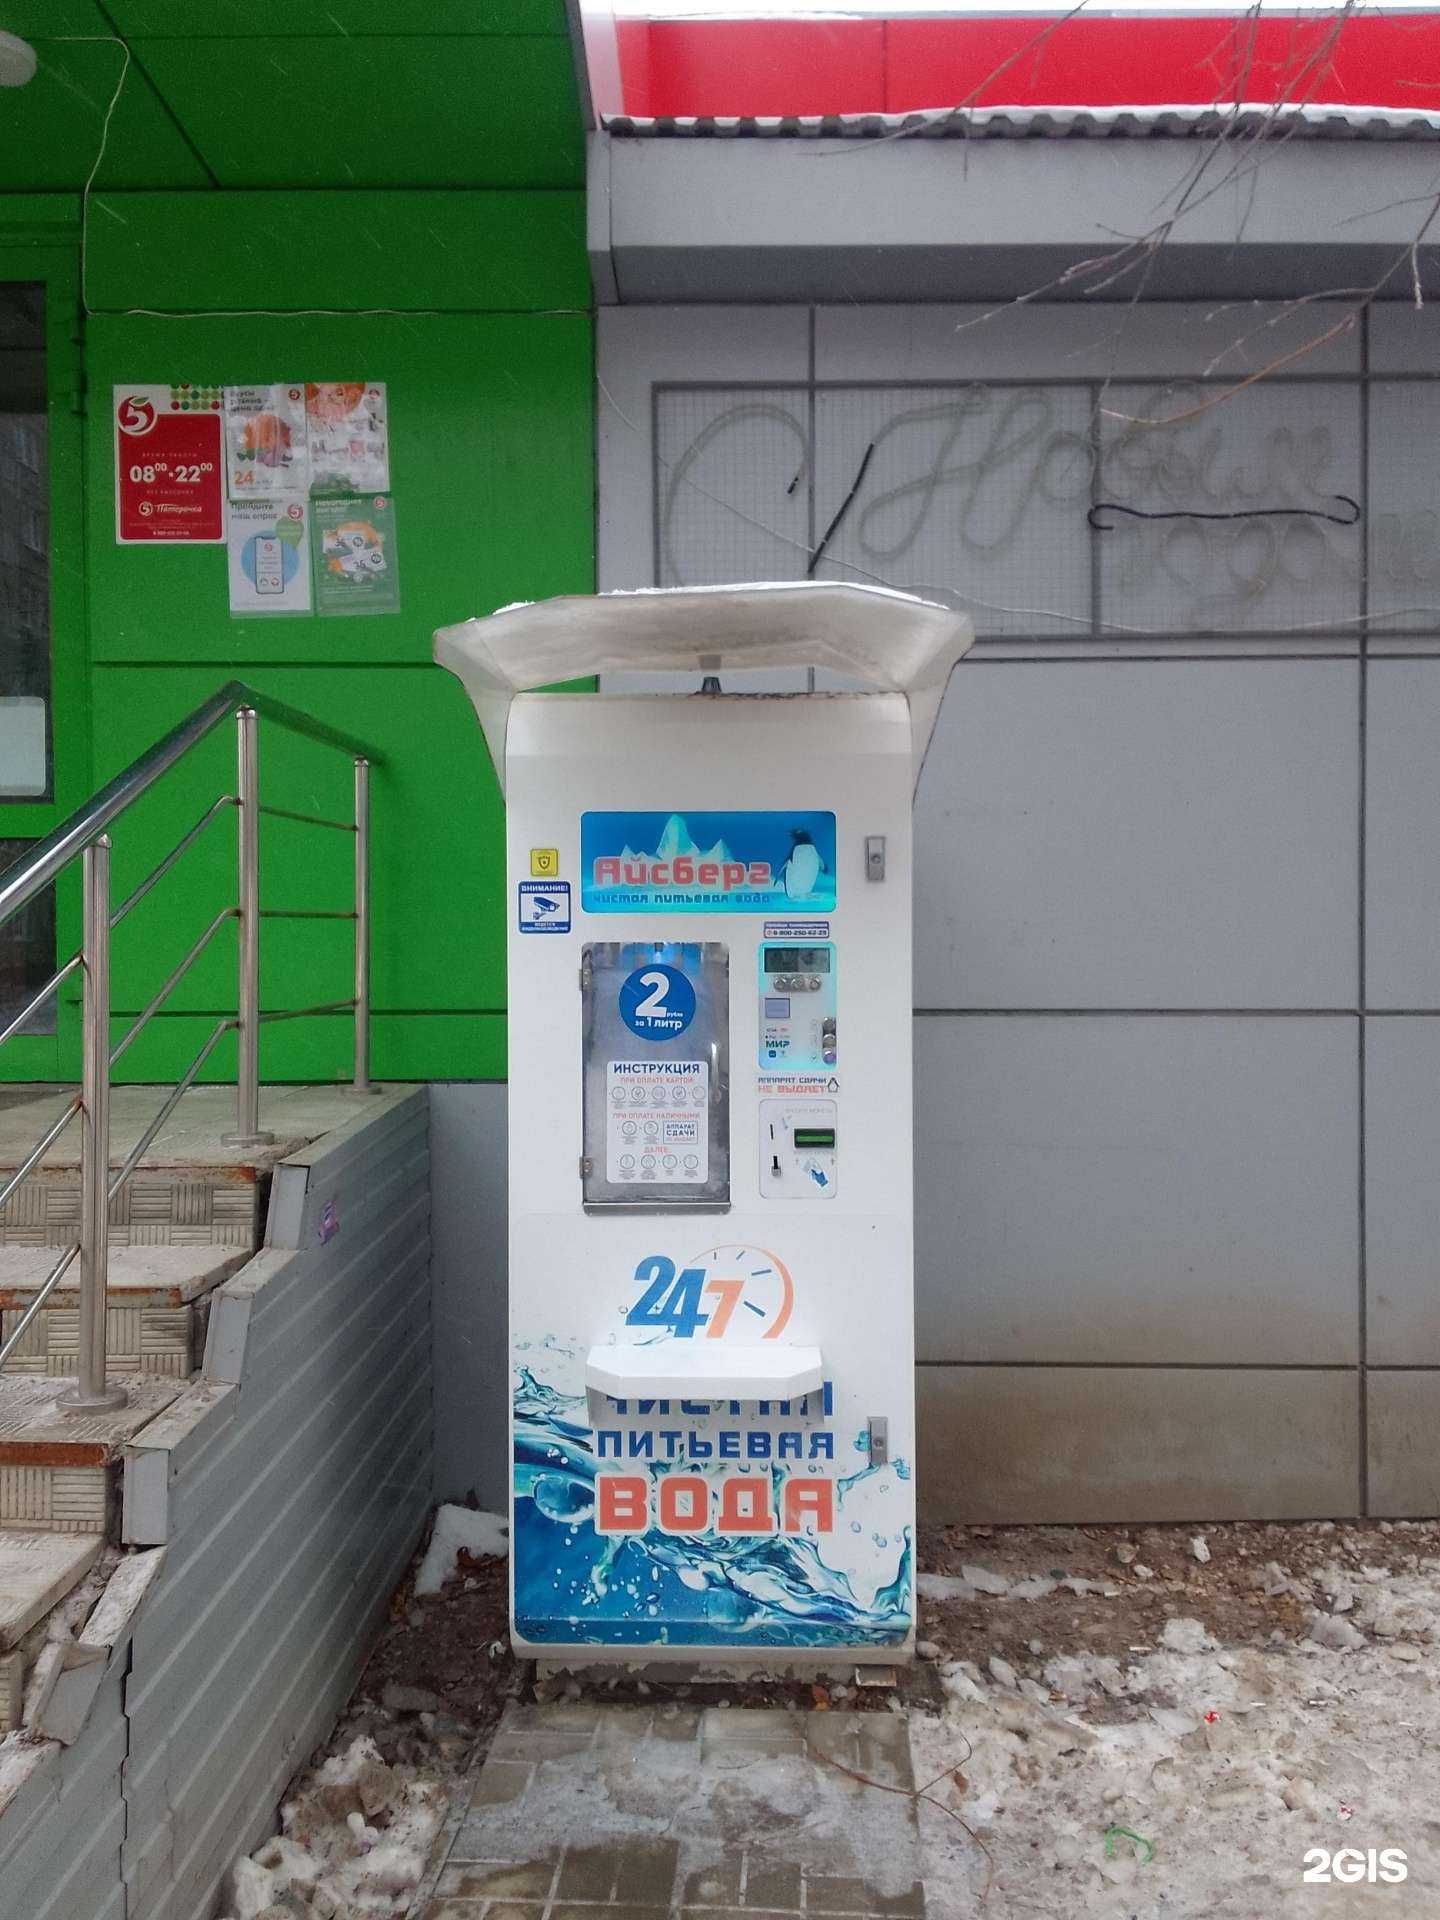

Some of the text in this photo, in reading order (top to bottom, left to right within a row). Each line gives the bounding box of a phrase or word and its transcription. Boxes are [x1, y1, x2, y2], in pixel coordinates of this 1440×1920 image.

[594, 856, 772, 891] Айсберг
[635, 971, 670, 1018] 2
[646, 1017, 652, 1027] 1
[654, 1020, 683, 1030] литр
[613, 1063, 700, 1075] ИНСТРУКЦИЯ
[597, 1430, 834, 1459] ПИТЬЕВАЯ
[599, 1476, 834, 1532] ВОДА
